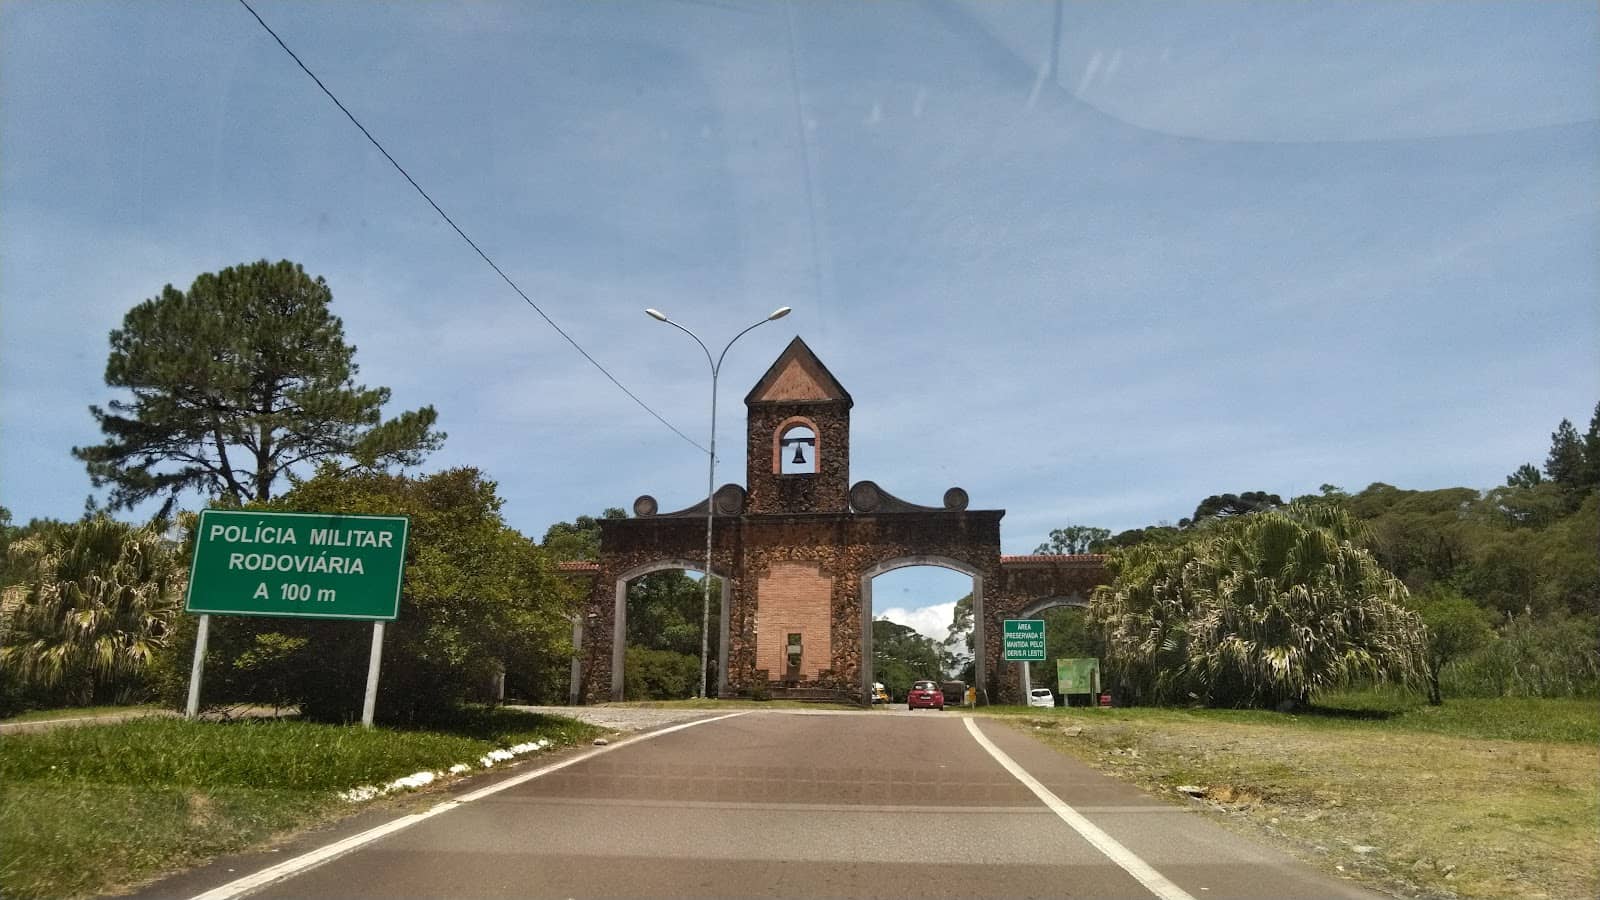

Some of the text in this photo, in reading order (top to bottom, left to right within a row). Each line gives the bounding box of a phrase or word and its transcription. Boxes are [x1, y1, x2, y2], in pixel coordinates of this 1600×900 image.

[210, 521, 393, 548] POLÍCIA MILITAR
[228, 551, 365, 575] RODOVIÁRIA
[253, 583, 337, 602] A 100 m
[1028, 649, 1044, 657] LESTE
